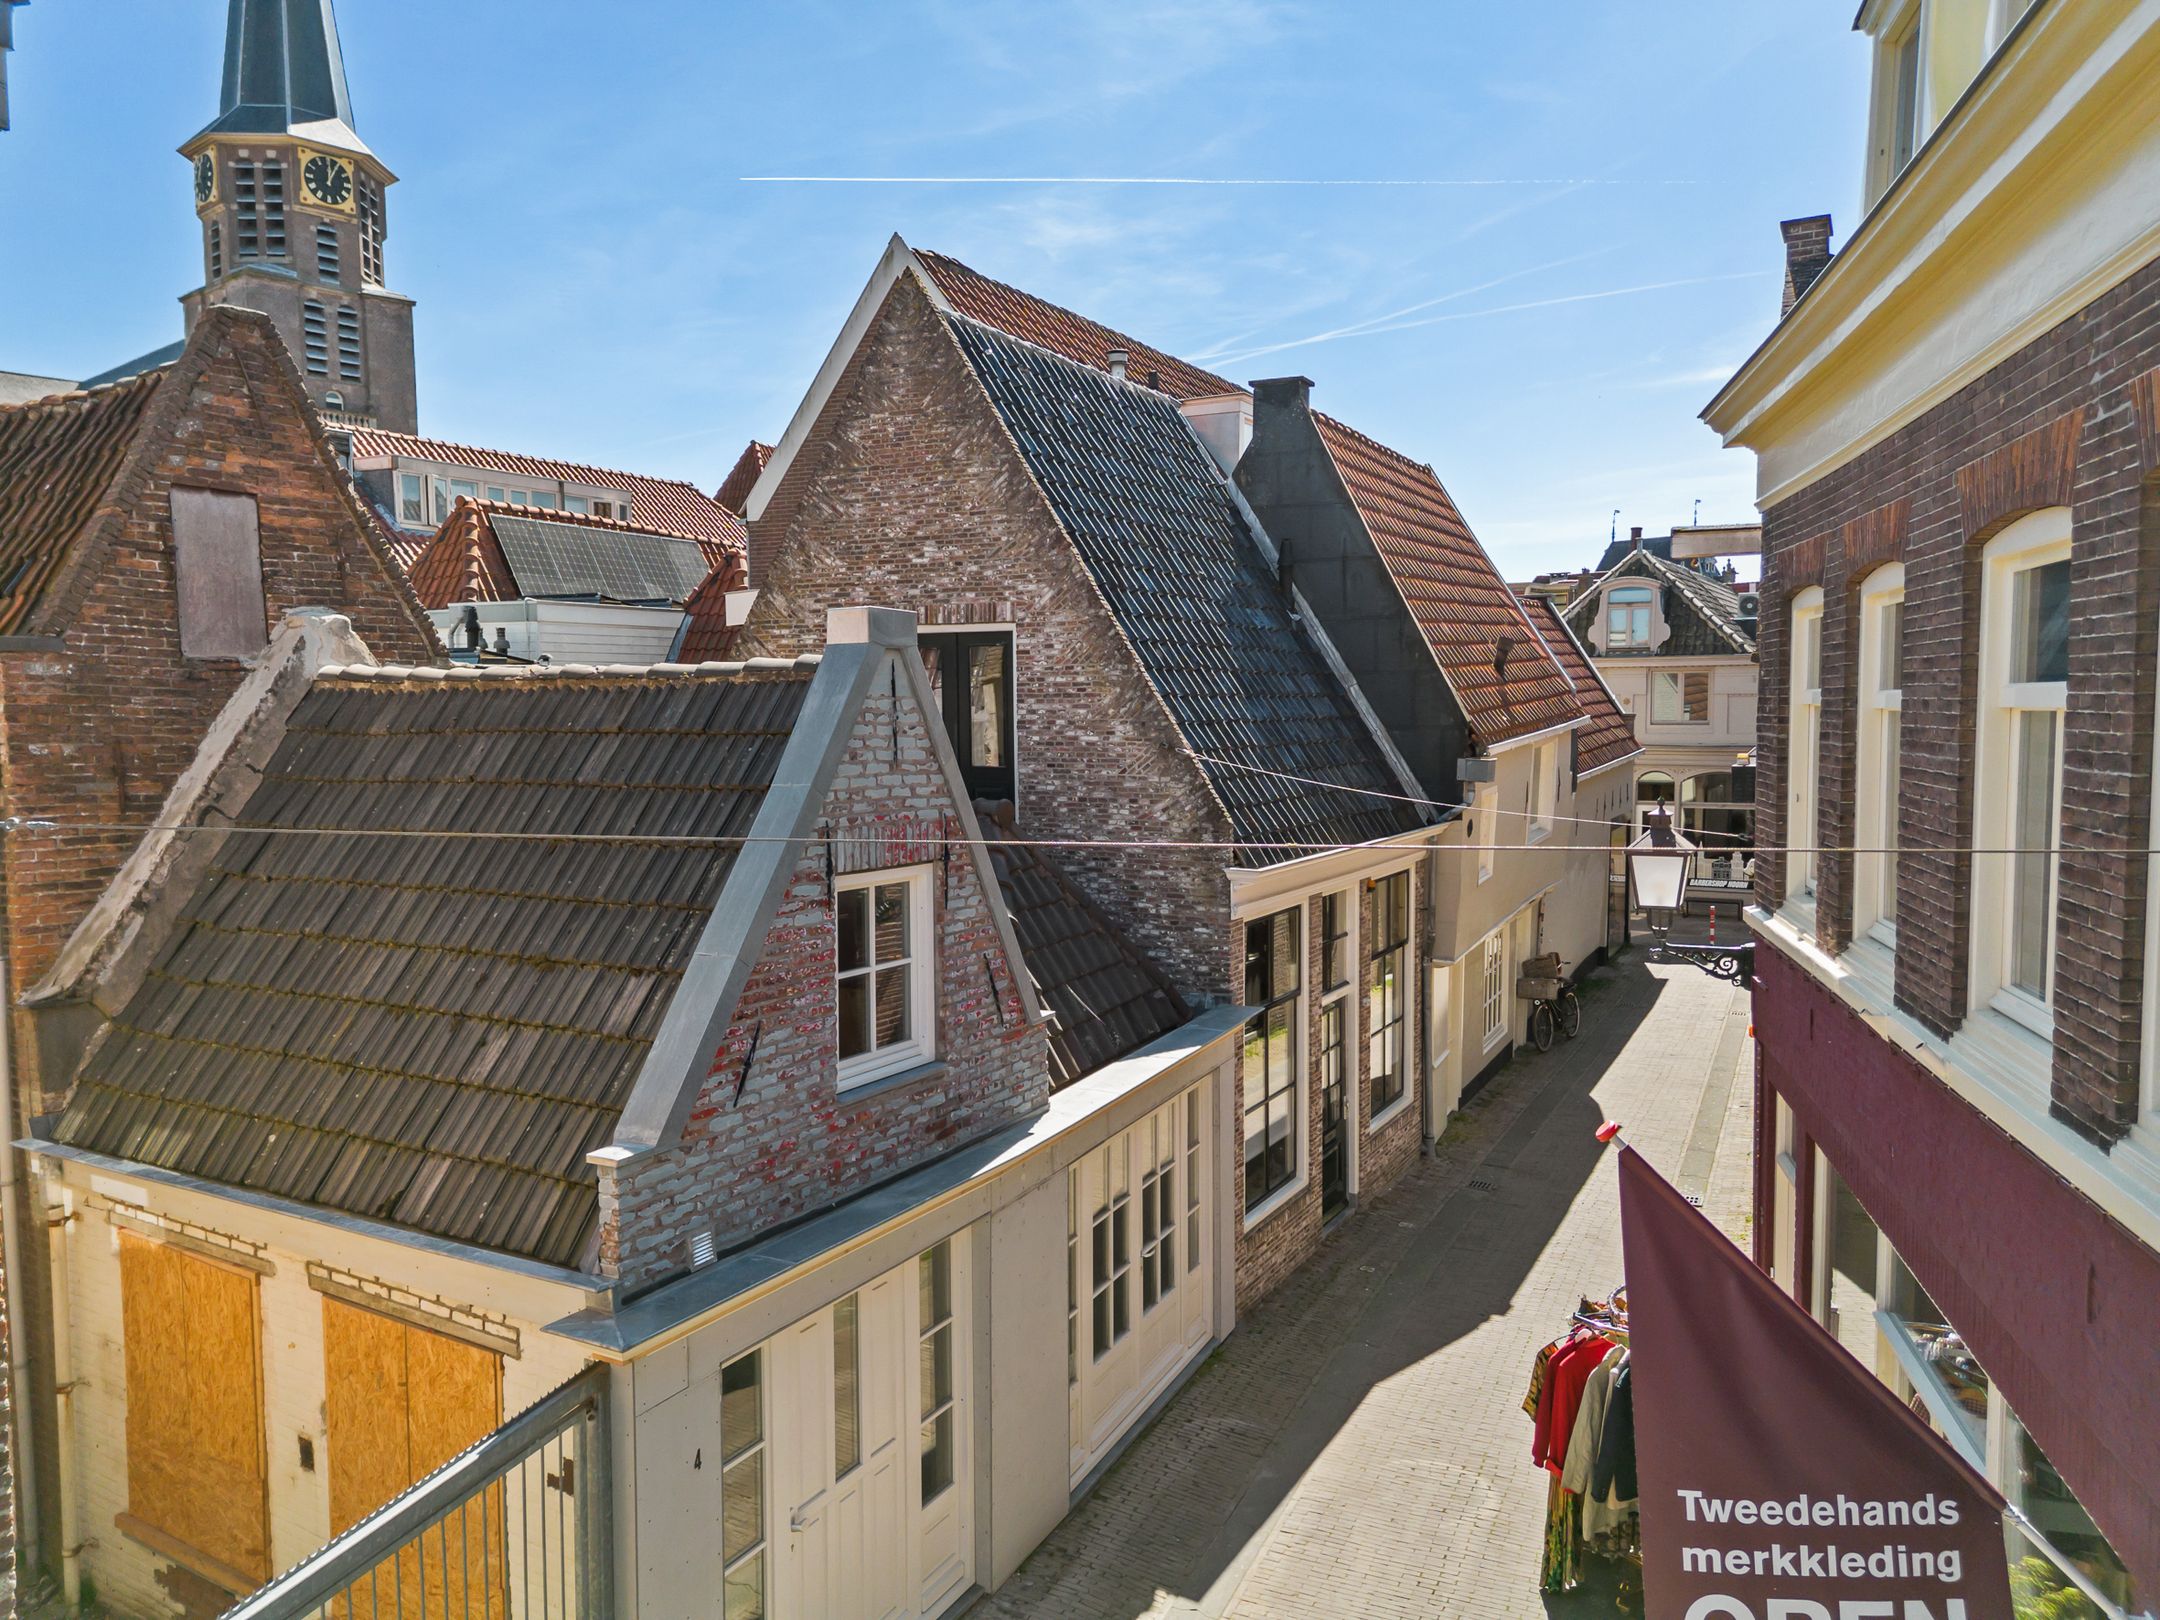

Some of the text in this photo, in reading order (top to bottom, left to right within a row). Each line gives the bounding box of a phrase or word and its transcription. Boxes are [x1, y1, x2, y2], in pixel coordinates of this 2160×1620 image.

[694, 1448, 702, 1470] 4
[1676, 1489, 1960, 1527] Tweedehands
[1682, 1543, 1962, 1583] merkkleding
